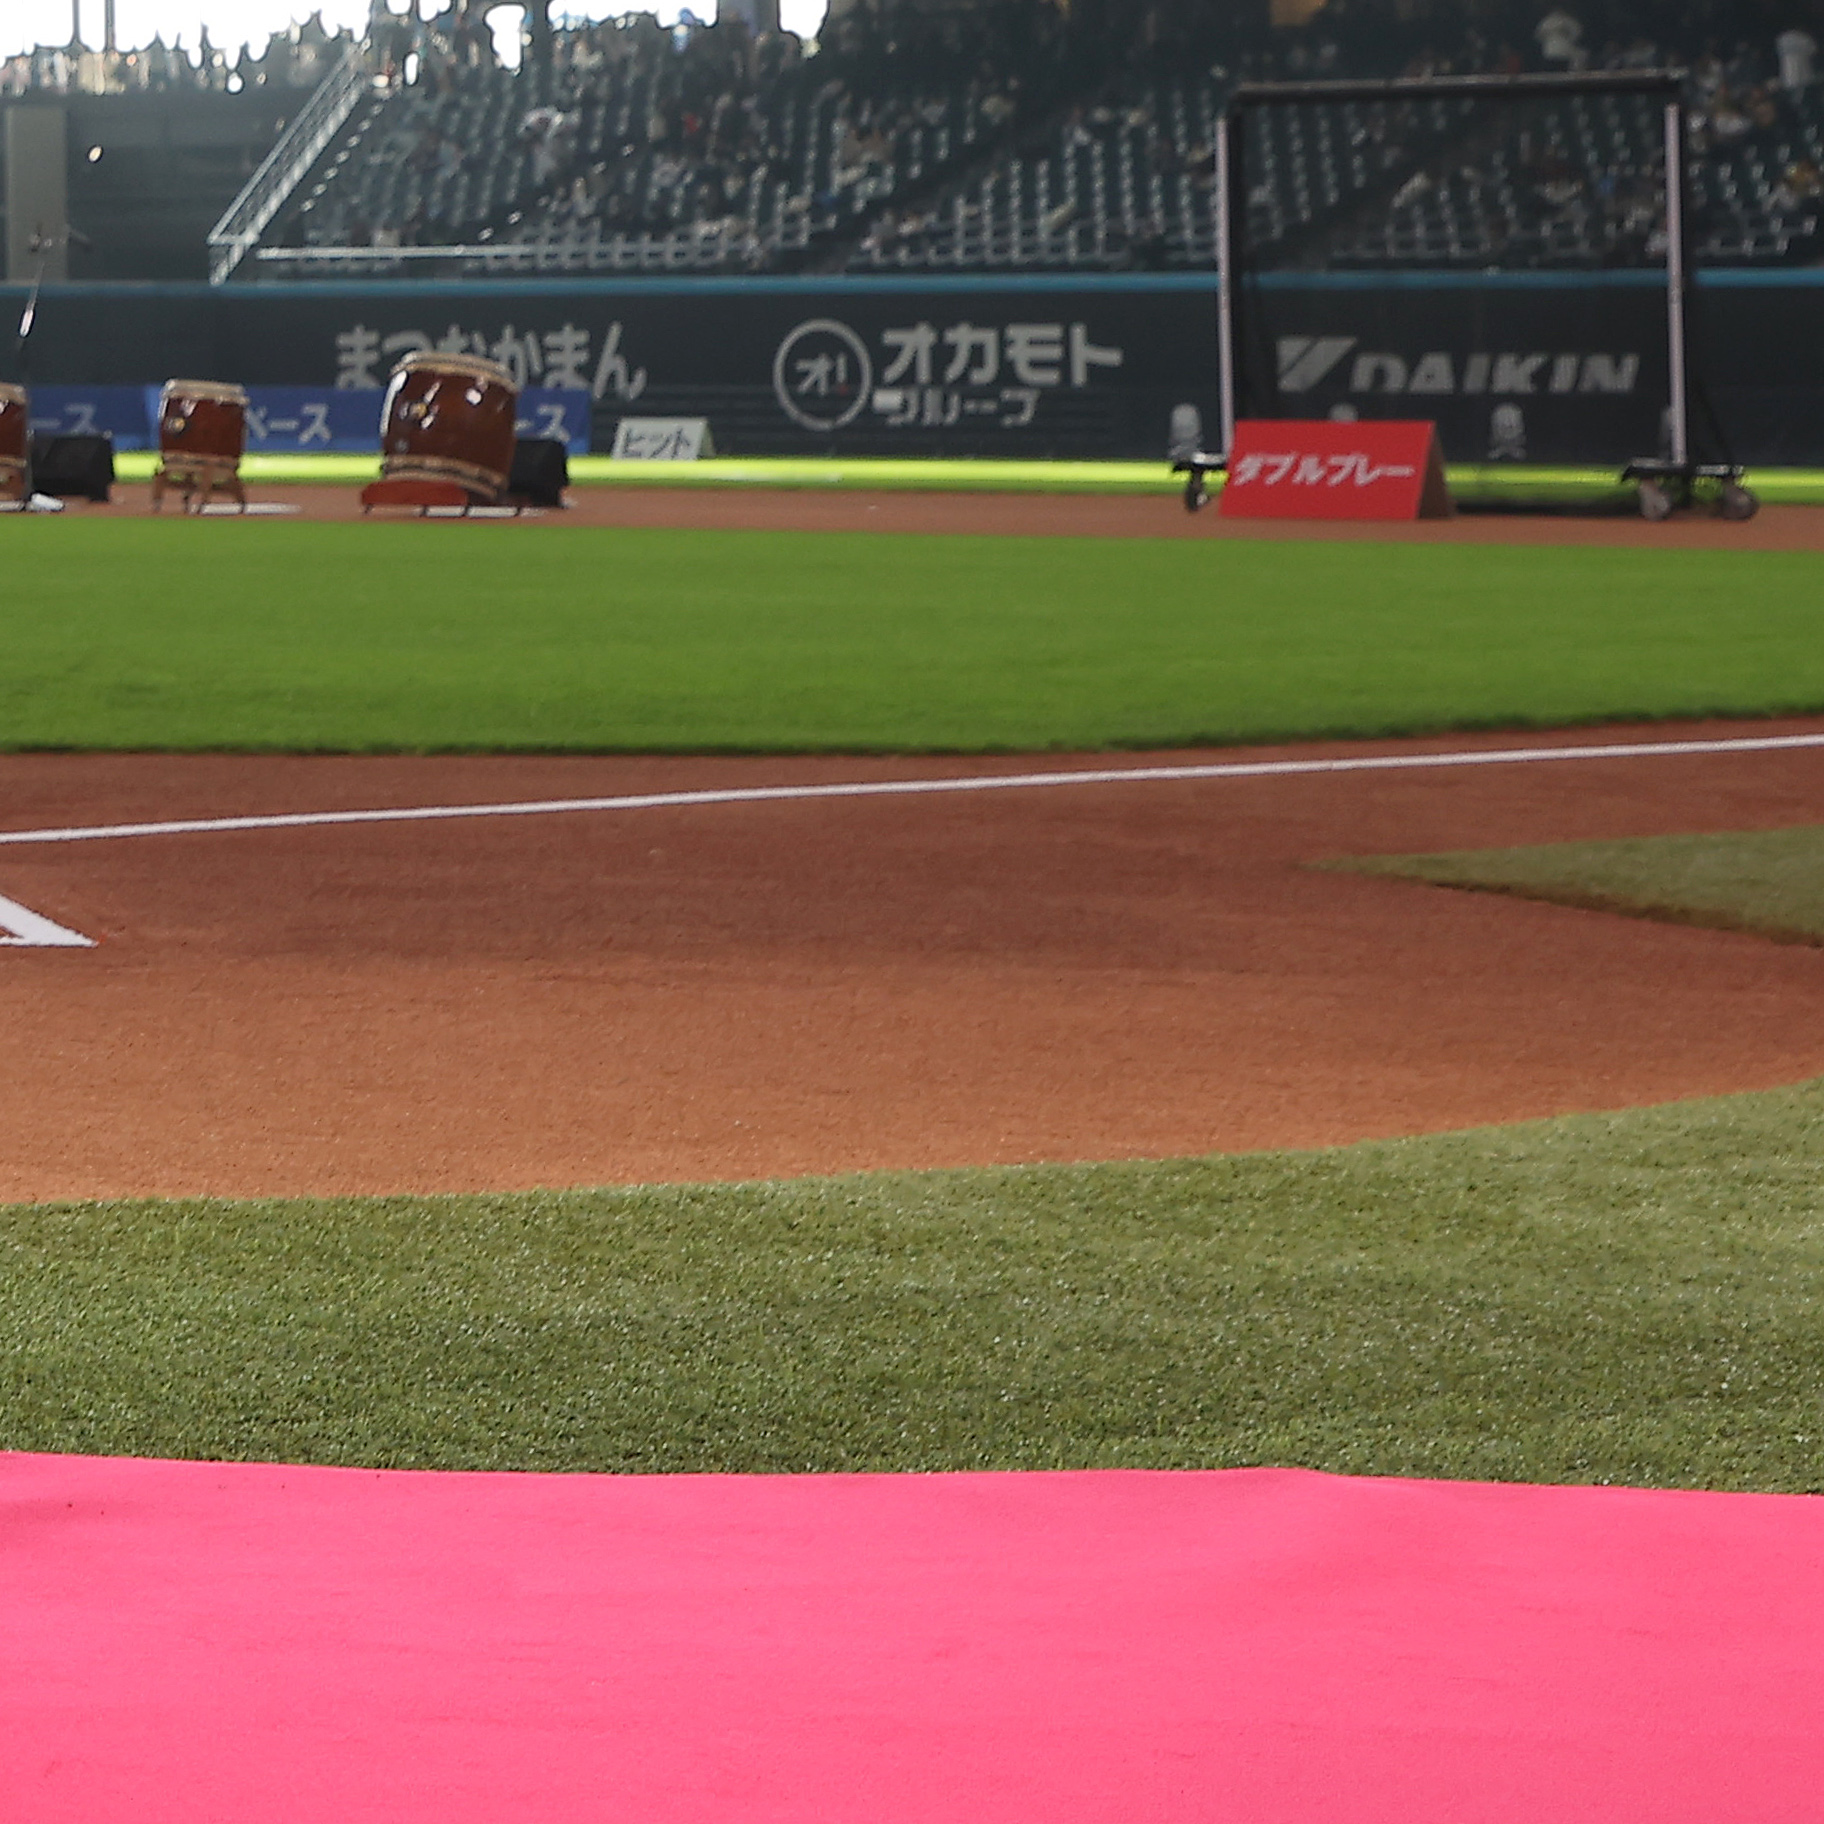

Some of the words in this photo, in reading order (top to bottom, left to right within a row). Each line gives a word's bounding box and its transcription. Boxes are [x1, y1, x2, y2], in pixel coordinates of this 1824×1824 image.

[881, 320, 1124, 388] オカモト
[1353, 352, 1640, 394] DAIKIN
[1233, 450, 1416, 488] ダブルプレー
